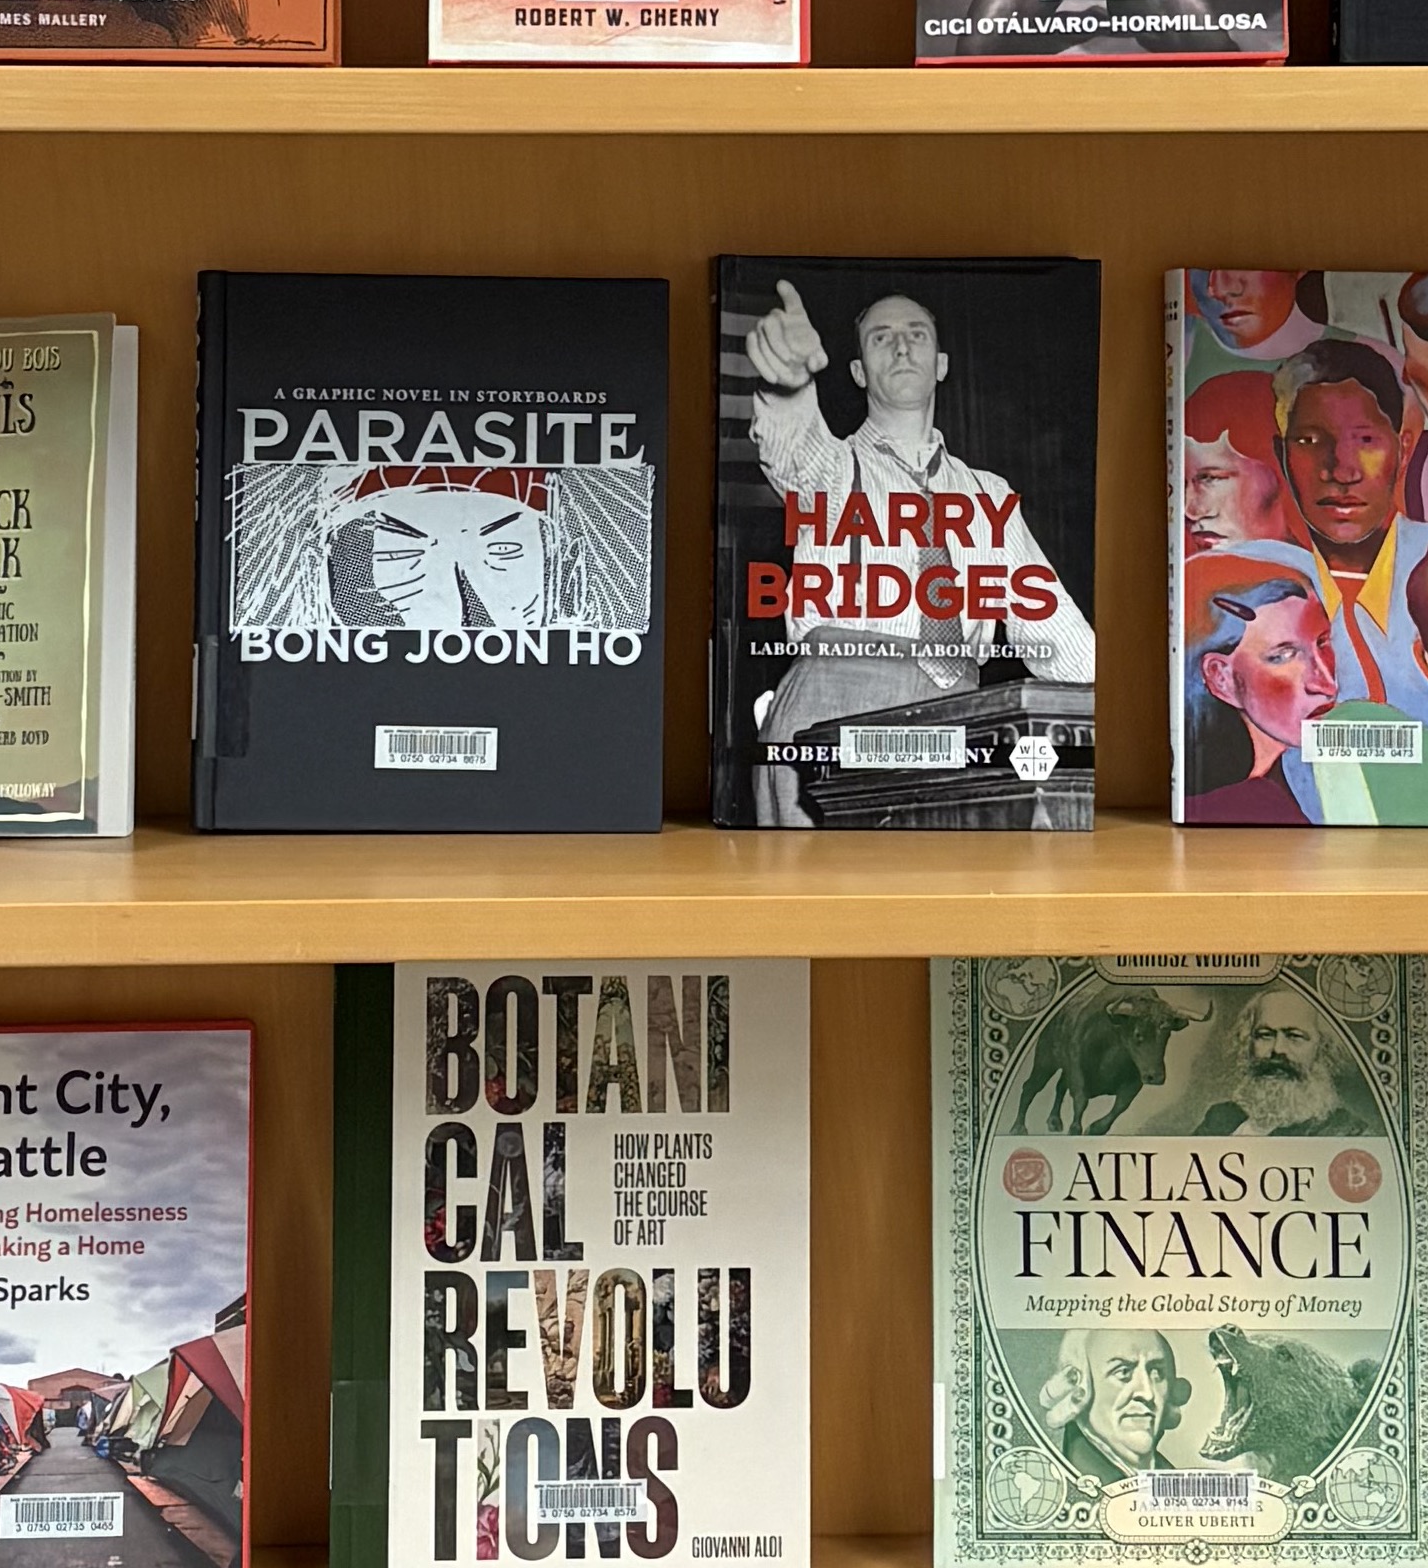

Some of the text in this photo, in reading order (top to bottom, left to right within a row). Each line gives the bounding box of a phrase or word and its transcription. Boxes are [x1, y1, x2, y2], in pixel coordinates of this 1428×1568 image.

[38, 13, 106, 26] MALLERY
[274, 388, 607, 404] A GRAPHIC NOVEL IN STORYBOARDS
[237, 408, 645, 465] PARASITE
[784, 491, 1021, 548] HARRY
[747, 563, 1059, 621] BRIDGES
[240, 629, 642, 665] BONG JOON HO
[750, 641, 1052, 659] LABOR RADICAL, LABOR LEGEND
[425, 975, 729, 1116] BOTANI
[56, 1070, 171, 1127] City,
[614, 1132, 712, 1159] HOW PLANTS
[614, 1161, 686, 1188] CHANGED
[1063, 1151, 1314, 1202] ATLAS OF
[424, 1122, 584, 1263] CAL
[614, 1190, 707, 1216] THE COURSE
[26, 1203, 187, 1223] Homelessness
[58, 1240, 70, 1256] a
[78, 1236, 144, 1256] Home
[614, 1219, 665, 1245] OF ART
[1014, 1211, 1370, 1280] FINANCE
[1025, 1294, 1362, 1317] Mapping the Global Story of Money
[422, 1268, 751, 1412] REVOLU
